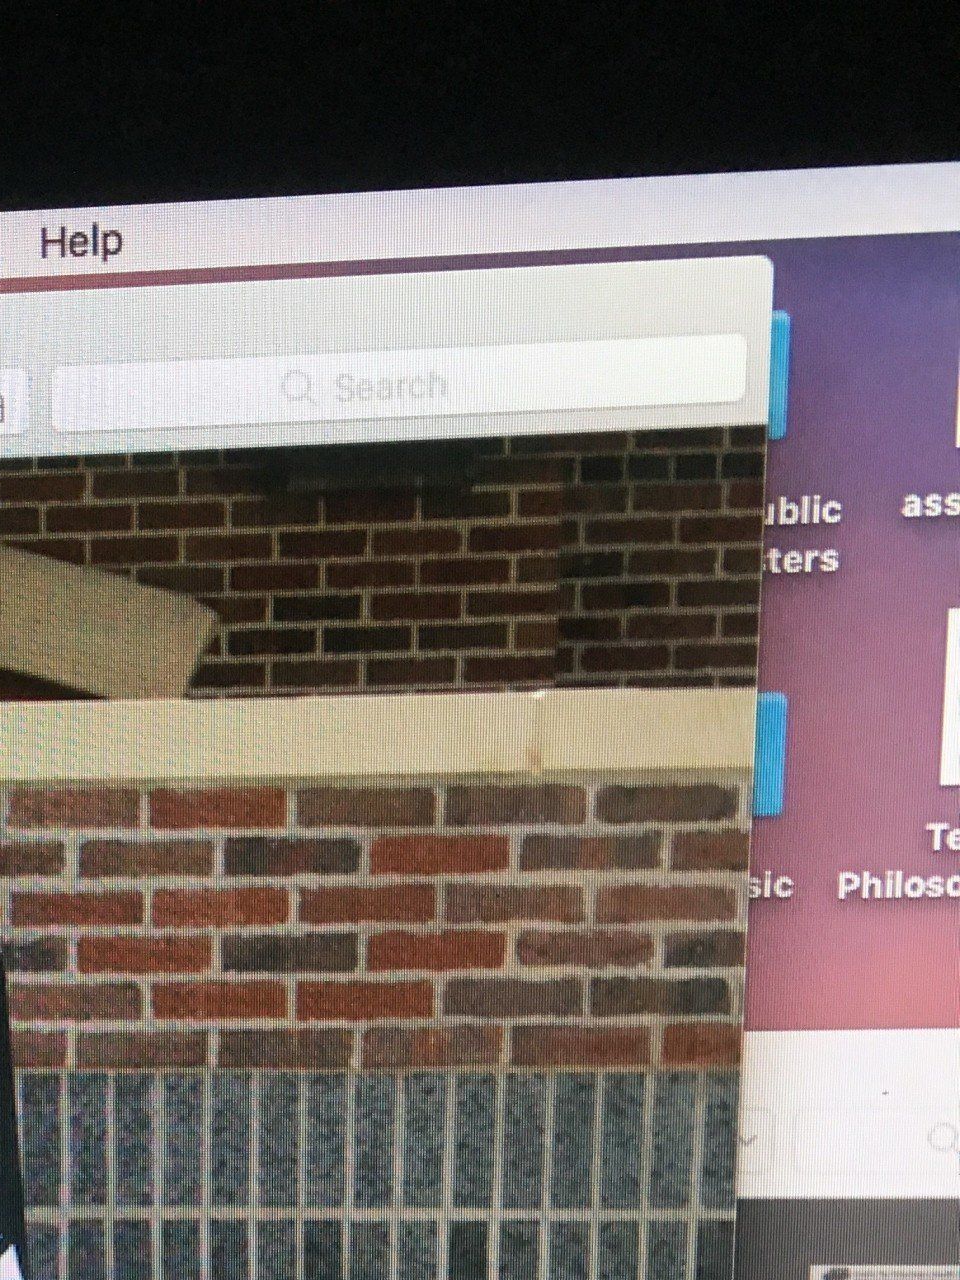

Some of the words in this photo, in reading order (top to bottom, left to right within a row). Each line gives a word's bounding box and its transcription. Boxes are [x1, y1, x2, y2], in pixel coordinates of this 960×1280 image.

[40, 221, 124, 260] Help
[335, 371, 448, 405] Search
[901, 492, 960, 517] ass
[762, 547, 839, 573] ters
